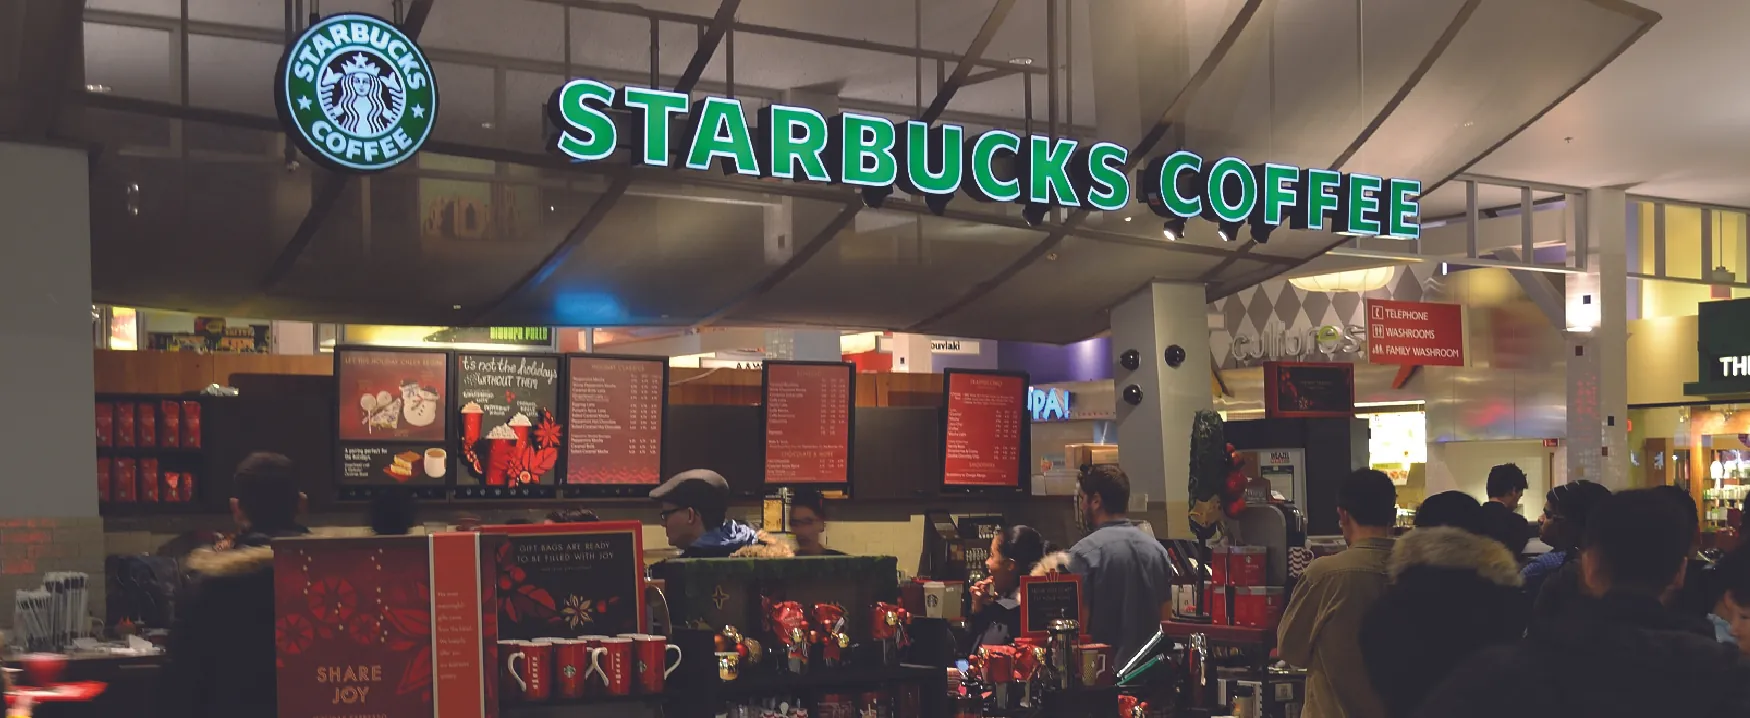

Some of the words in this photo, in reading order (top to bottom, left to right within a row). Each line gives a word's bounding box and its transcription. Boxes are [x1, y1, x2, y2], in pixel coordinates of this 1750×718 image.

[294, 22, 426, 90] STARBUCKS
[311, 119, 413, 162] COFFEE
[557, 78, 1130, 211] STARBUCKS
[1159, 150, 1421, 240] COFFEE
[1384, 308, 1429, 321] TELEPHONE
[1385, 327, 1435, 340] WASHROOMS
[1385, 344, 1411, 356] FAMILY
[1412, 346, 1459, 358] WASHROOM
[478, 356, 496, 372] not
[497, 356, 517, 373] the
[517, 356, 557, 385] holidays
[477, 374, 514, 387] WITHOUT
[541, 543, 563, 552] BAGS
[585, 540, 611, 550] READY
[574, 551, 595, 561] WITH
[316, 665, 383, 683] SHARE
[332, 685, 370, 705] JOY
